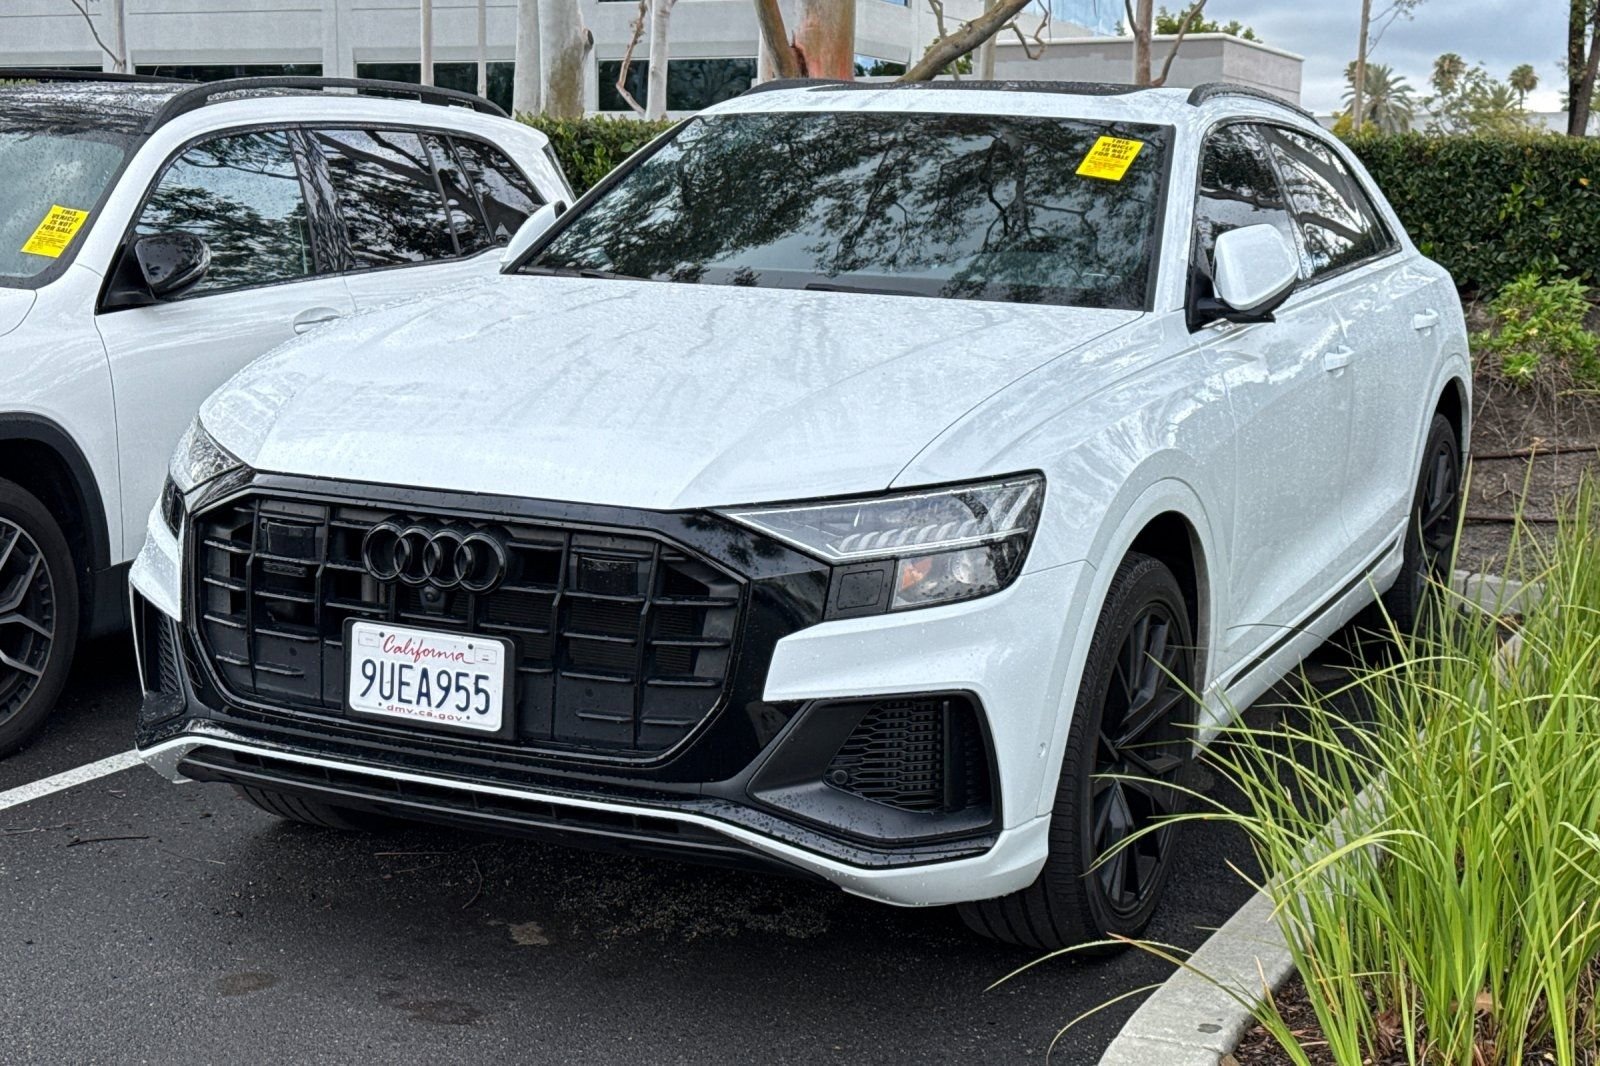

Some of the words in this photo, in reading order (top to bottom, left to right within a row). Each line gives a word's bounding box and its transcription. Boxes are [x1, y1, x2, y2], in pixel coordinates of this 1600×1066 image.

[383, 634, 475, 664] California
[360, 659, 490, 715] 9UEA955
[386, 704, 463, 721] dmv.ca.gov
